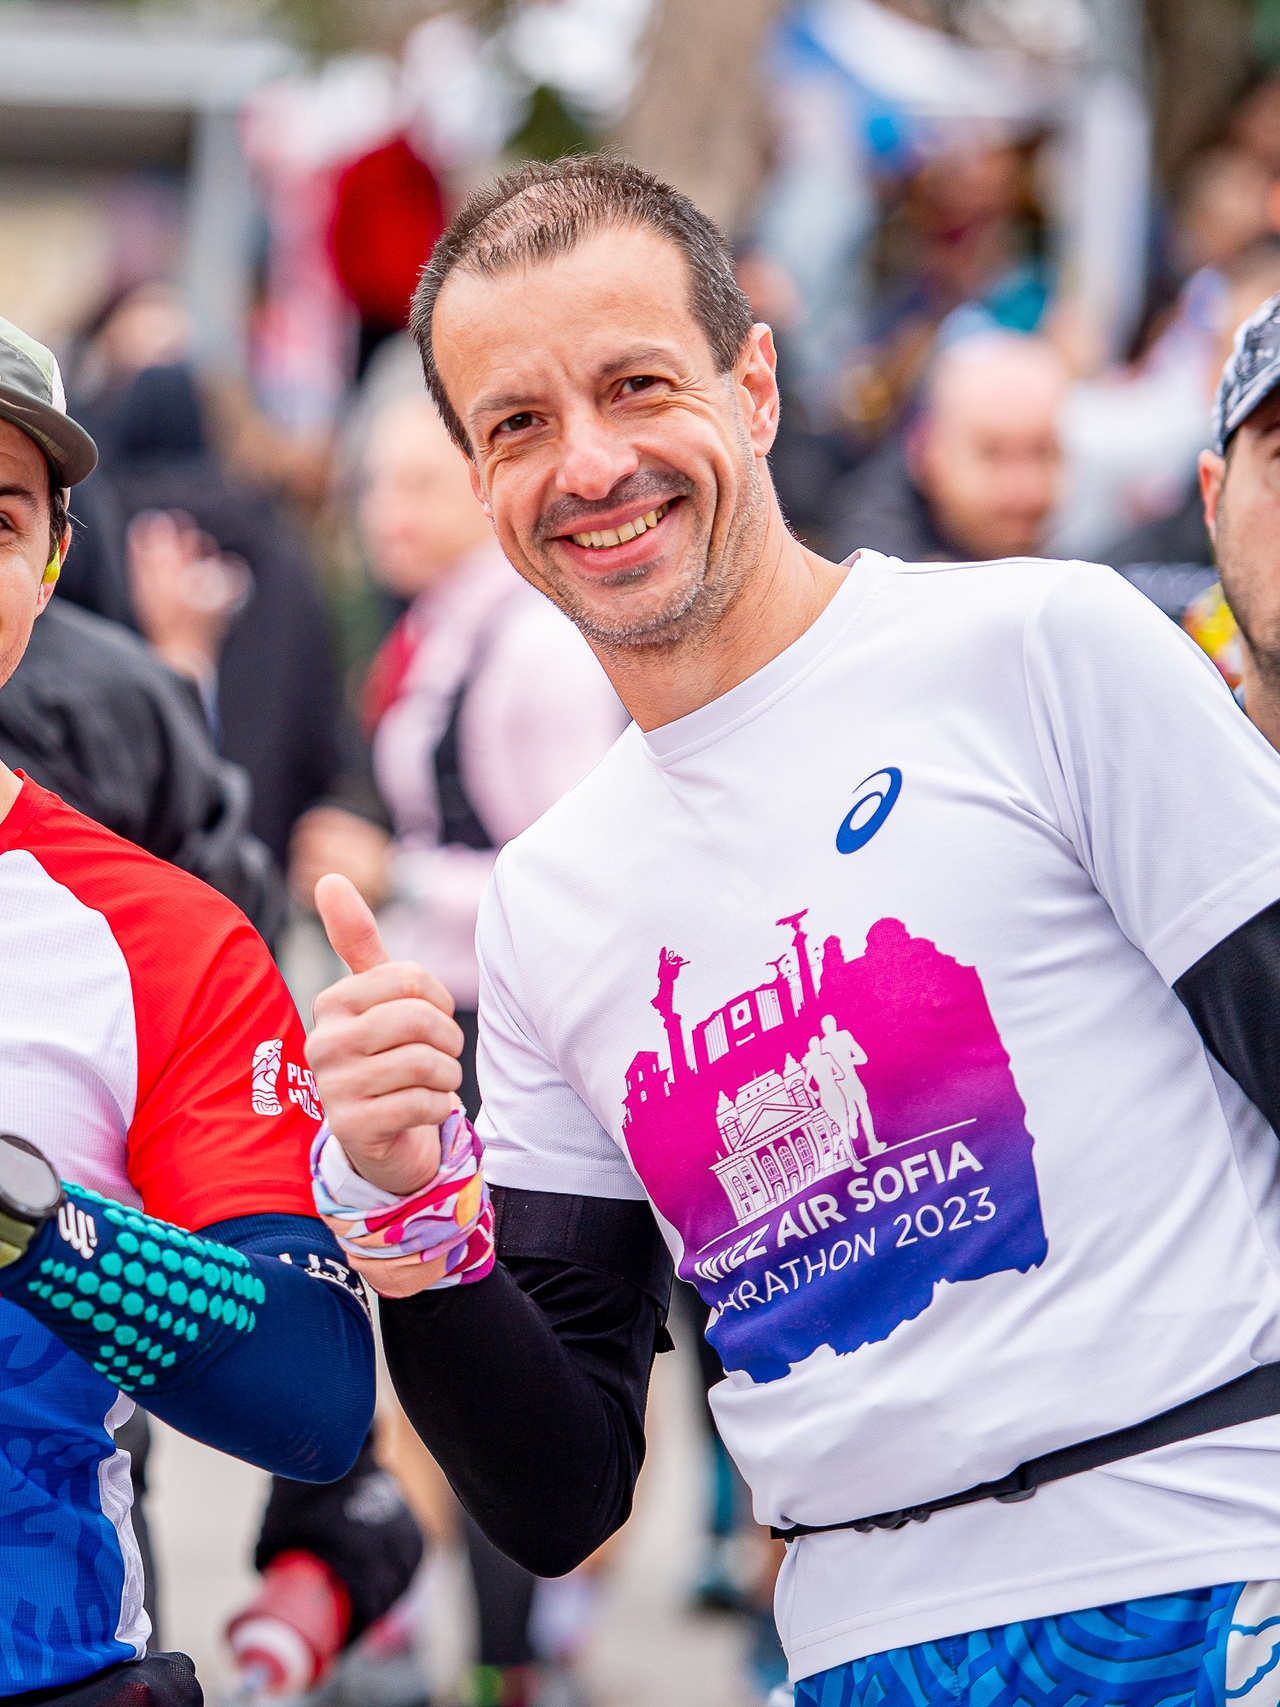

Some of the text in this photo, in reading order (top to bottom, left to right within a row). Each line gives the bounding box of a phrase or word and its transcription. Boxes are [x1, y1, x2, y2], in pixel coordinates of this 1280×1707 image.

[694, 1141, 984, 1283] WIZZ AIR SOFIA
[893, 1186, 996, 1248] 2023
